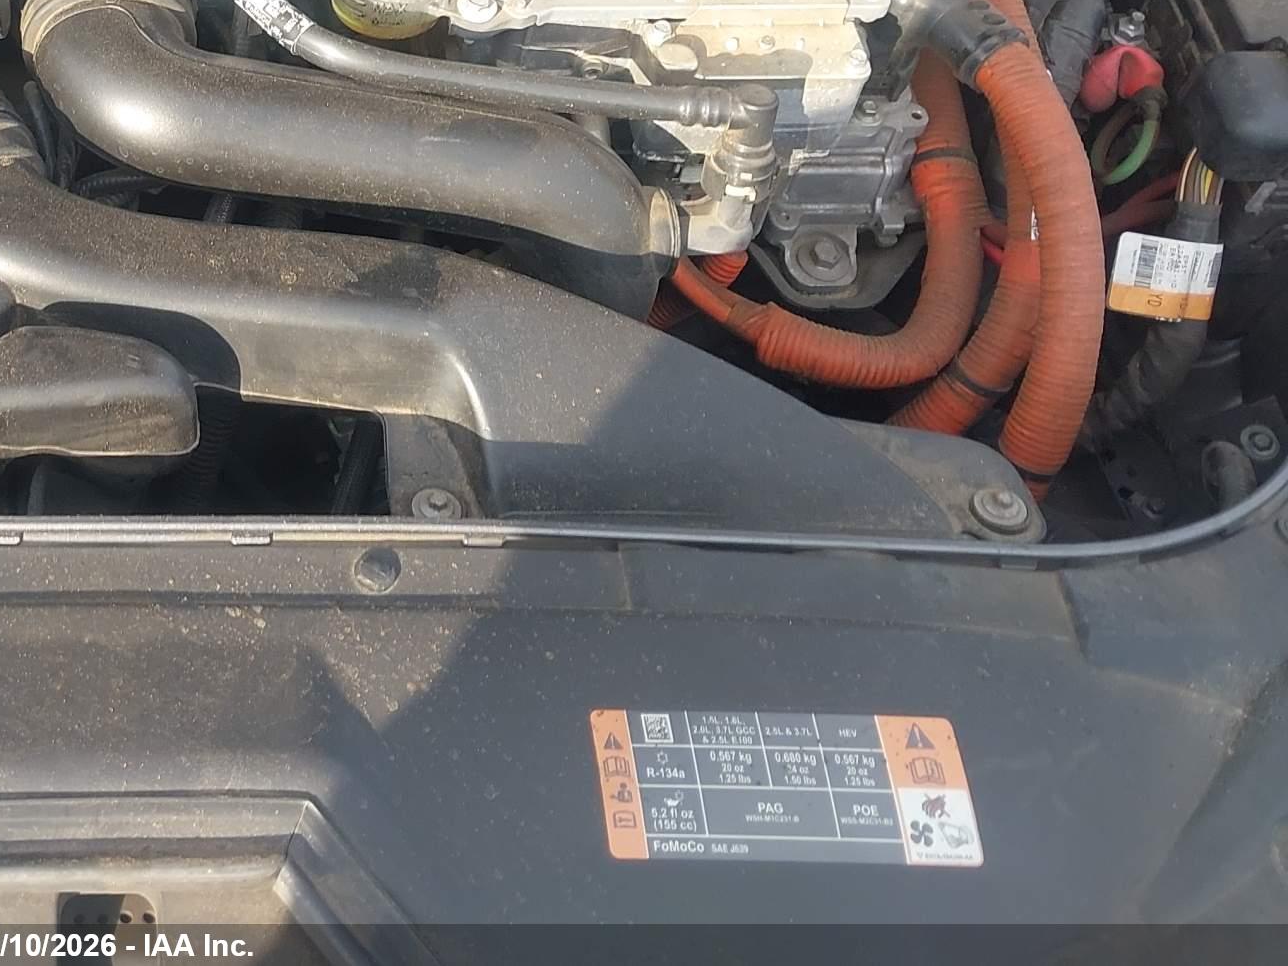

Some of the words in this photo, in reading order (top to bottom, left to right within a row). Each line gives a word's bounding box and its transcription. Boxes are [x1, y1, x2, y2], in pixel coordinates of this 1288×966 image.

[838, 730, 857, 738] HEV
[710, 752, 735, 762] 0.567
[738, 752, 752, 764] kg
[774, 752, 800, 763] 0.680
[803, 753, 816, 765] kg
[834, 754, 859, 764] 0.567
[862, 755, 875, 768] kg
[646, 768, 685, 778] R-134a
[722, 764, 732, 773] 20
[734, 765, 744, 773] oz
[800, 766, 809, 774] oz
[847, 767, 857, 775] 20
[859, 768, 868, 776] oz
[719, 774, 736, 783] 1.25
[738, 775, 751, 784] lbs
[784, 776, 802, 785] 1.50
[803, 776, 816, 786] lbs
[844, 778, 860, 786] 1.25
[862, 778, 875, 787] lbs
[757, 802, 784, 814] PAG
[853, 805, 878, 816] POE
[651, 808, 666, 818] 5.2
[670, 808, 678, 818] fl
[681, 810, 694, 819] oz
[654, 820, 676, 831] (155
[680, 821, 697, 832] cc)
[654, 840, 704, 853] FoMoCo
